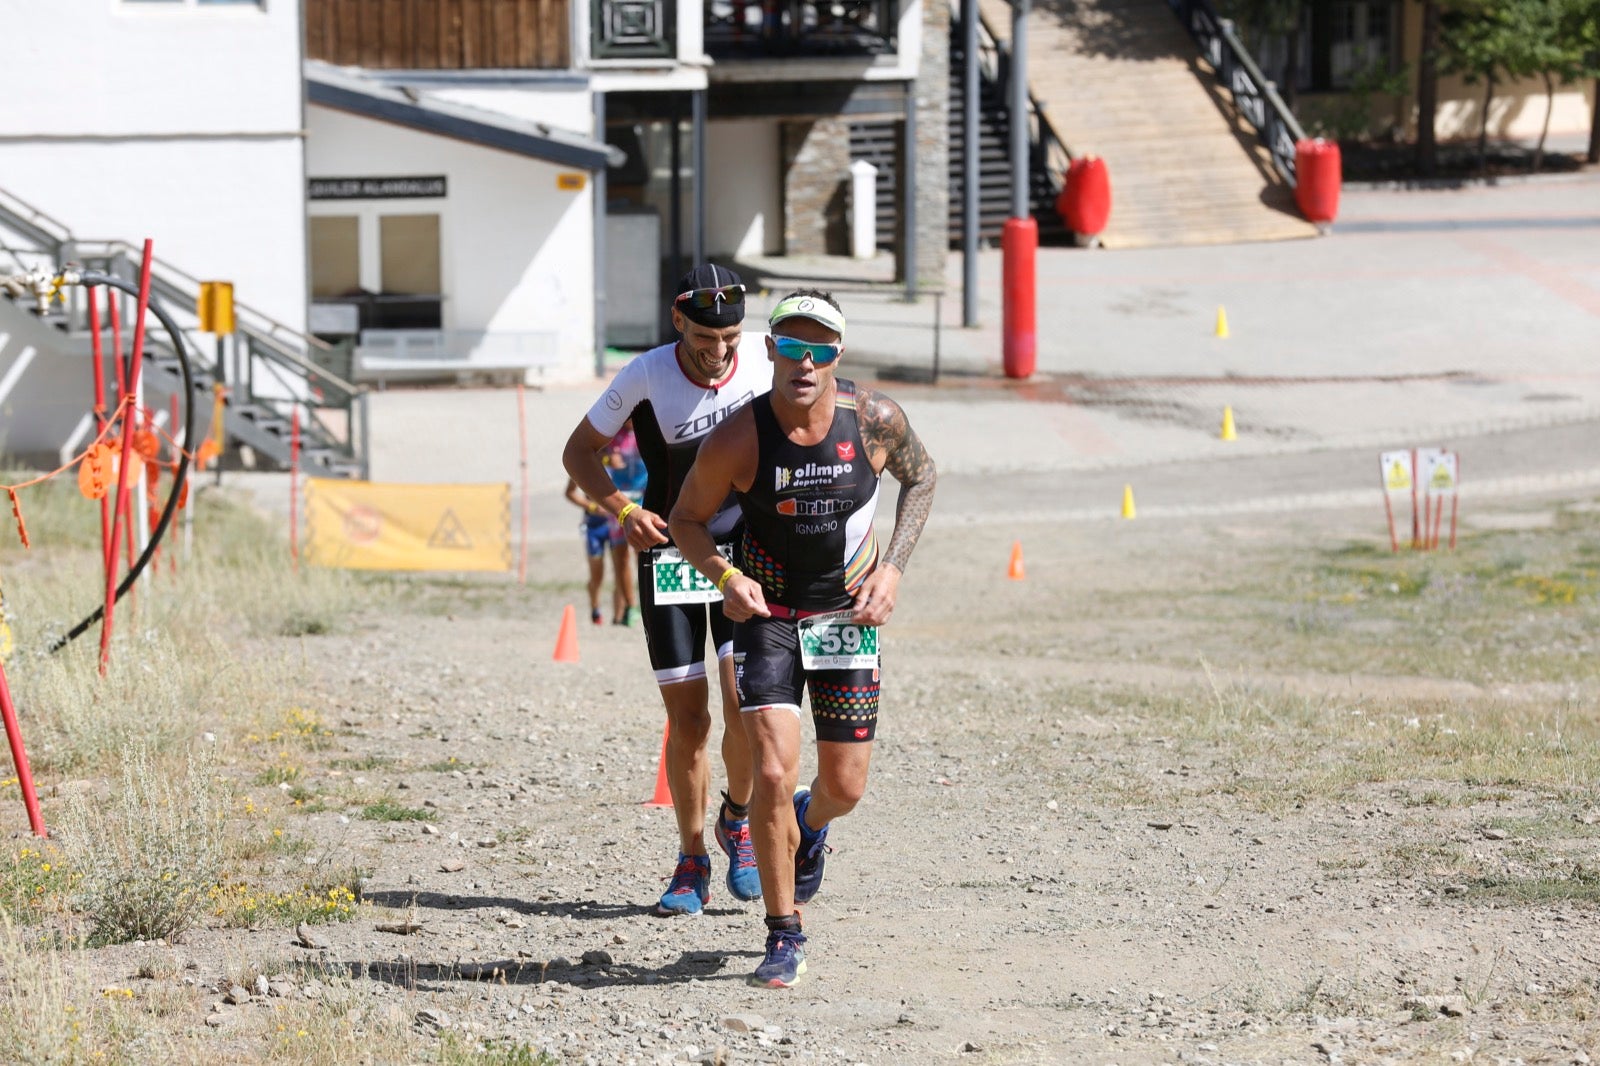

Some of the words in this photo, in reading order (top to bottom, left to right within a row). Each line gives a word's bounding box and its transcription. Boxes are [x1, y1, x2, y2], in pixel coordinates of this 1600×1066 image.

[794, 462, 853, 478] olimpo
[793, 478, 832, 487] deportes
[795, 520, 838, 534] IGNACIO
[821, 625, 861, 653] 59
